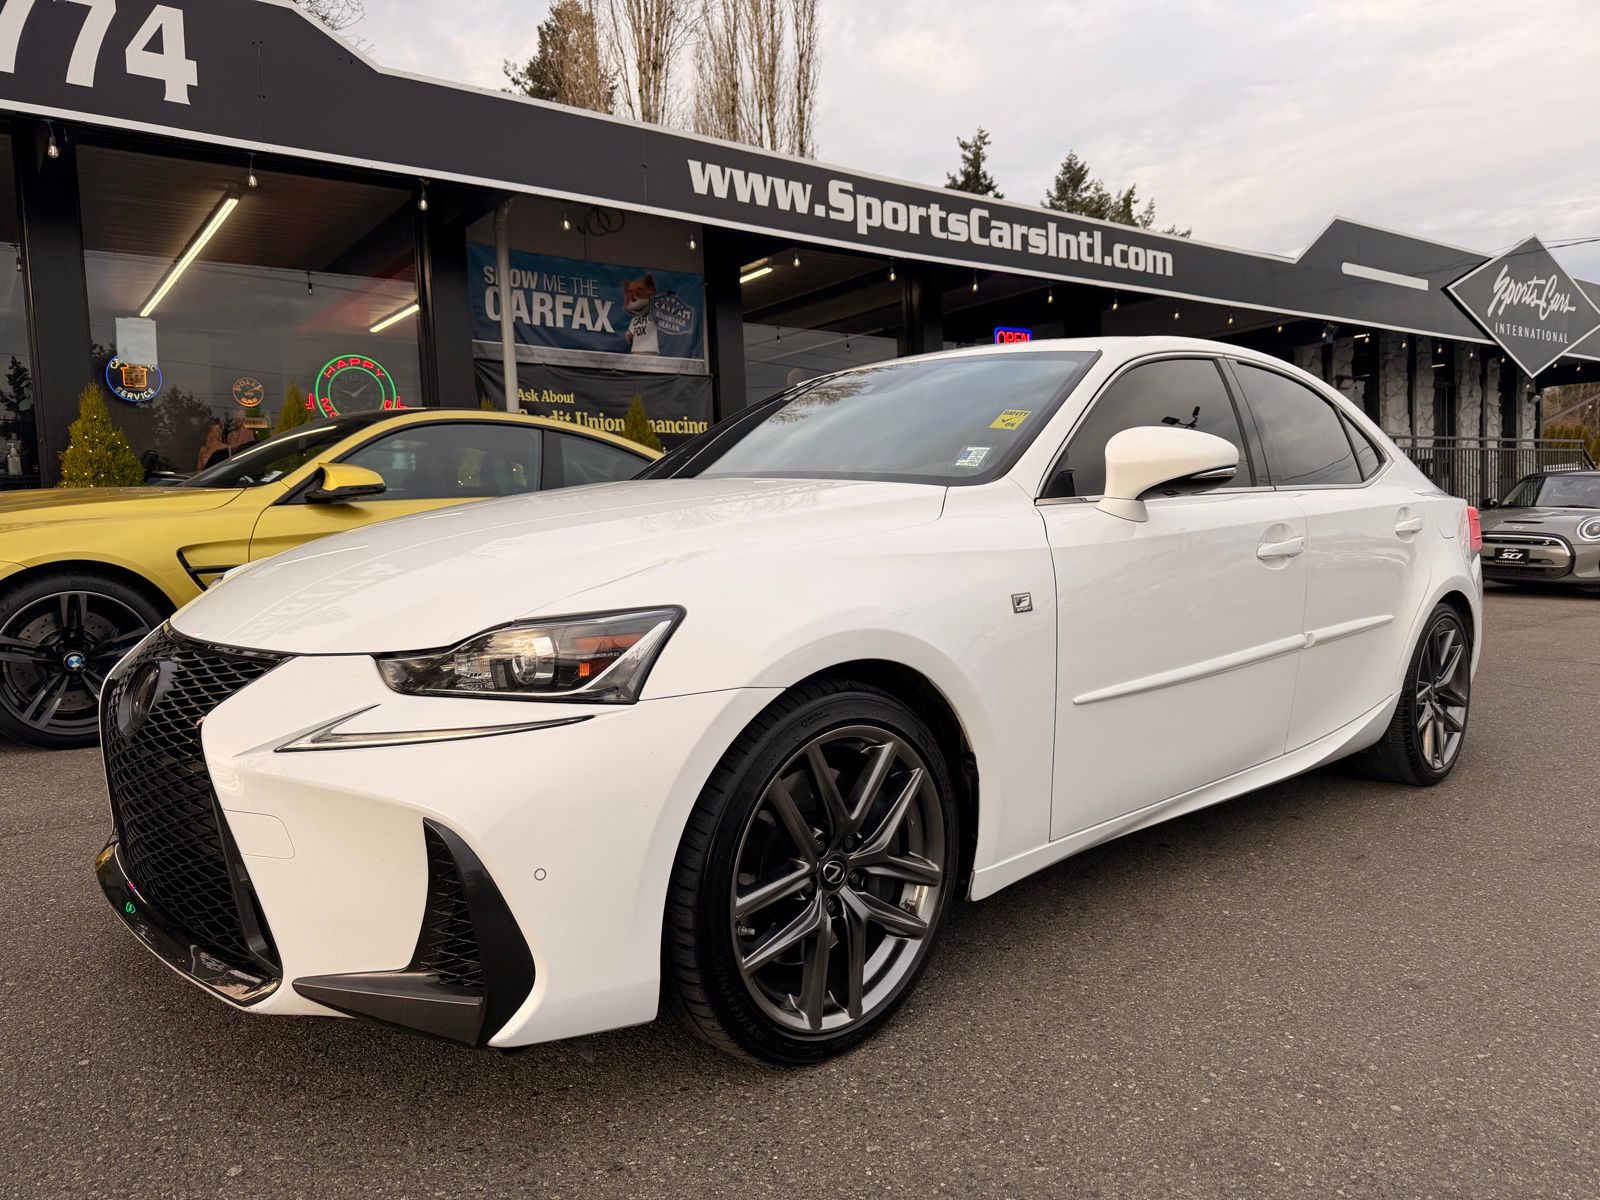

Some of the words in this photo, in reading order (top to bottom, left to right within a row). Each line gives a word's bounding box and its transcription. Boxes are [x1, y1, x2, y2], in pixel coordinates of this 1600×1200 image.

[687, 158, 1174, 277] www.SportsCarsIntl.com
[543, 273, 568, 294] ME
[570, 276, 600, 298] THE
[1487, 264, 1546, 318] Sports
[1538, 274, 1577, 321] Cars
[484, 286, 615, 334] CARFAX
[633, 315, 648, 326] CAR
[654, 301, 691, 320] CARFAX
[633, 326, 647, 336] FOX
[996, 330, 1030, 344] OPEN
[1494, 322, 1569, 344] INTERNATIONAL
[323, 357, 385, 379] HAPPY
[115, 386, 155, 400] SERVICE
[517, 388, 539, 402] Ask
[541, 389, 576, 404] About
[574, 411, 625, 432] Union
[648, 415, 708, 434] nancing
